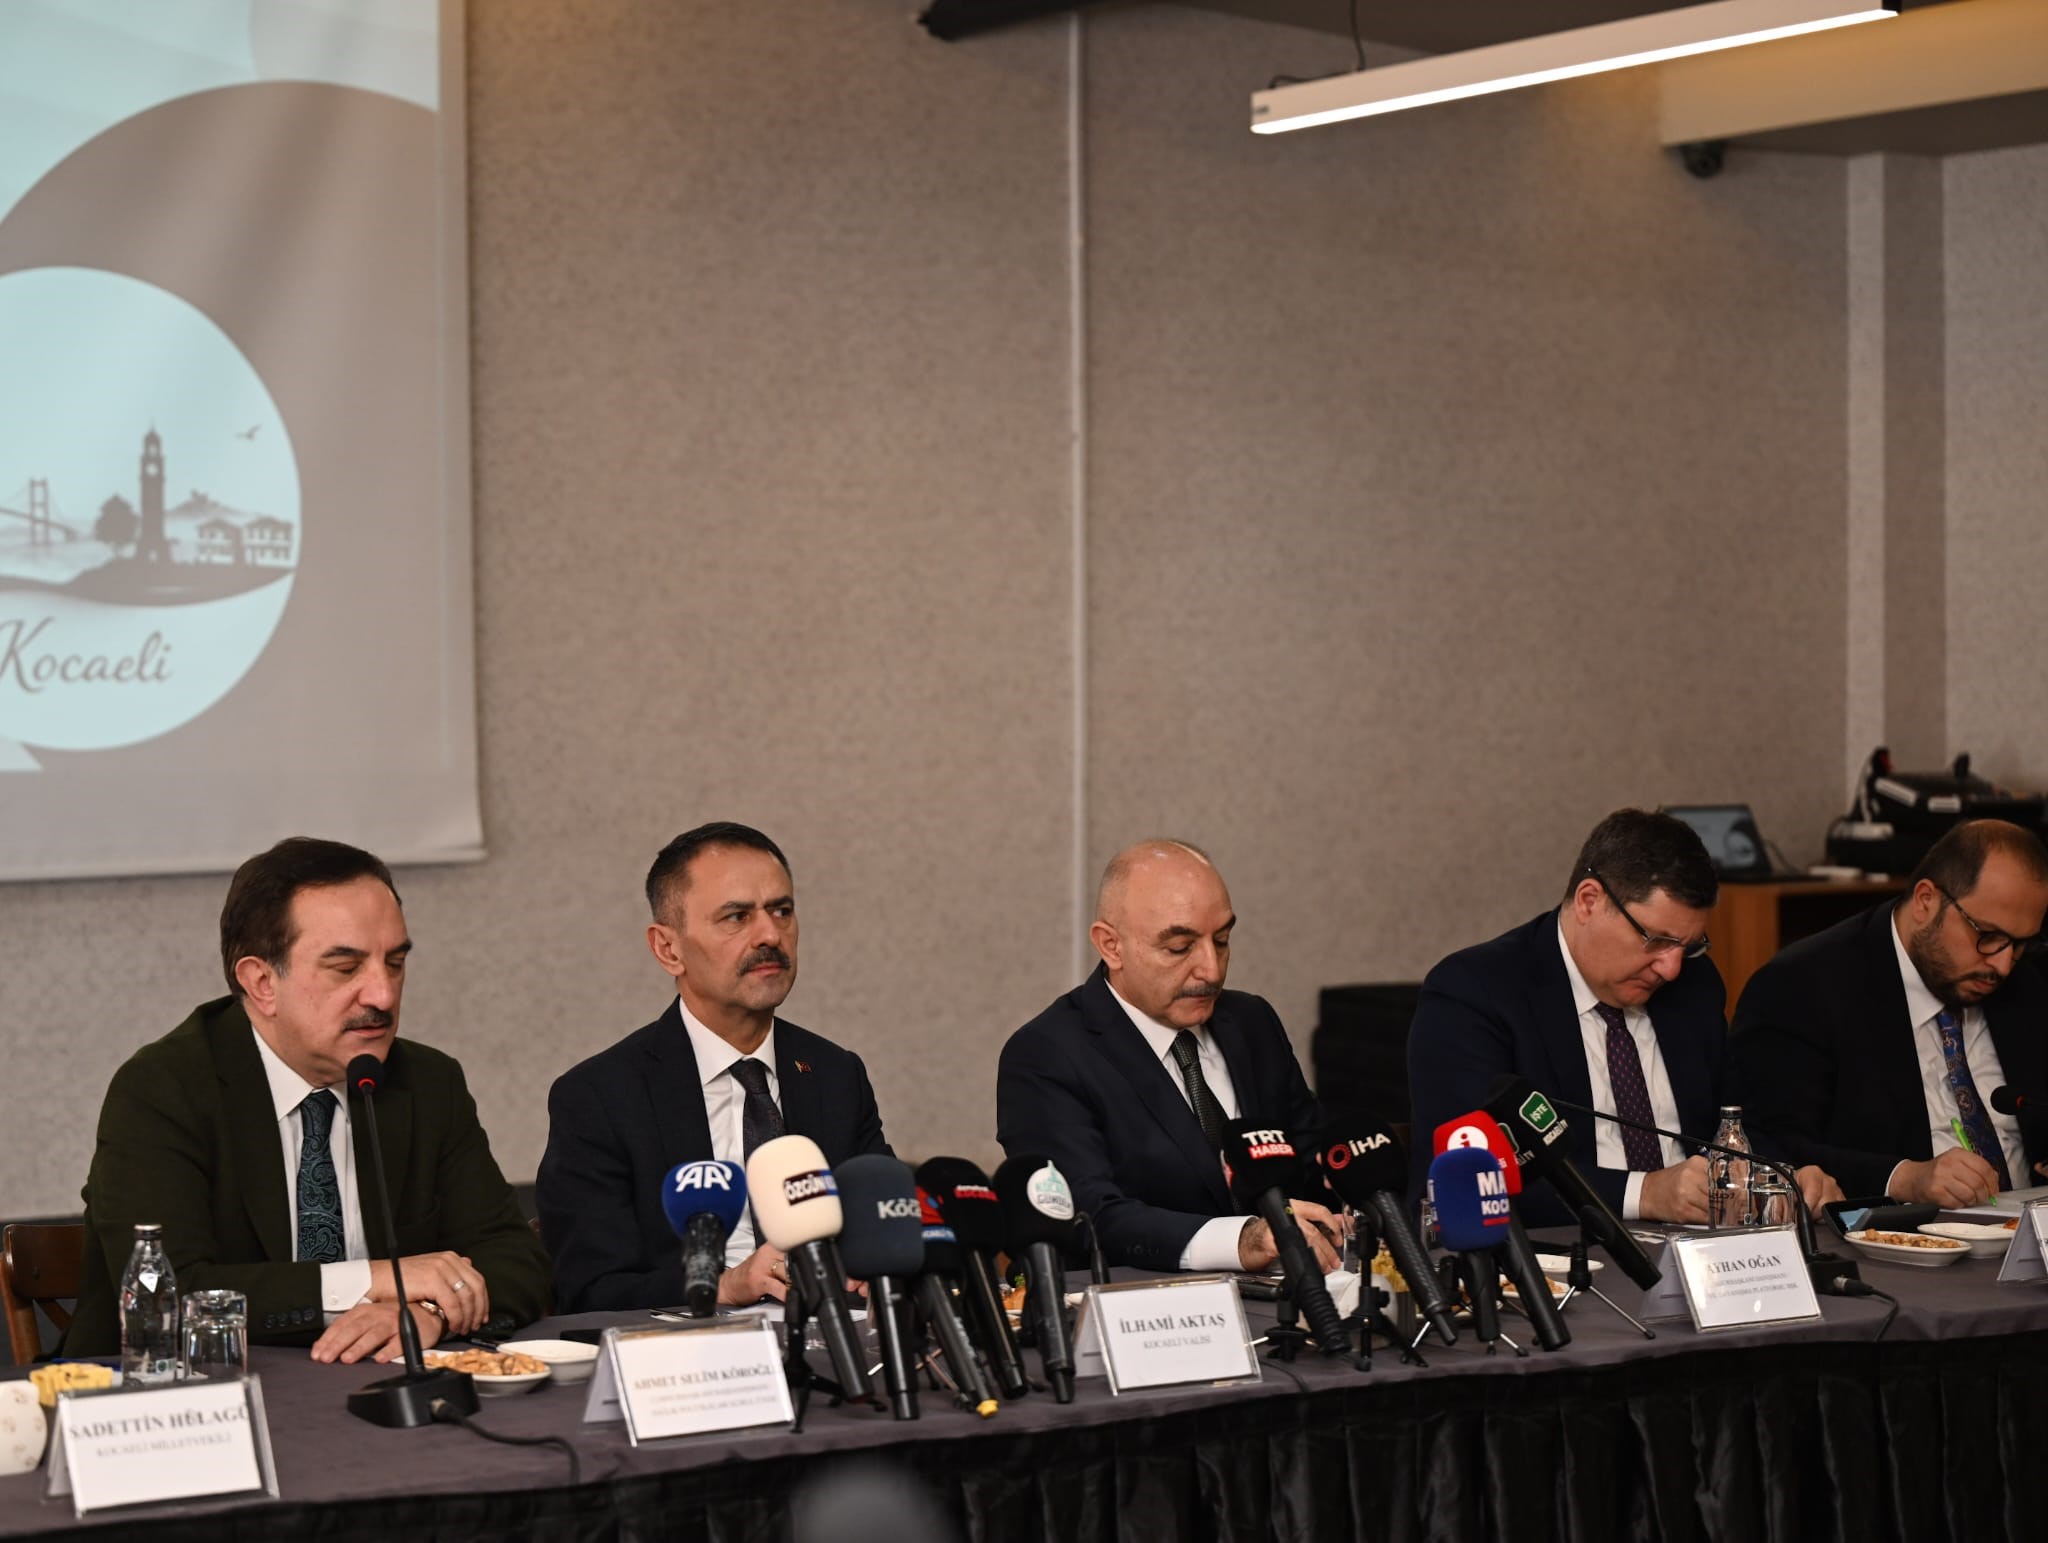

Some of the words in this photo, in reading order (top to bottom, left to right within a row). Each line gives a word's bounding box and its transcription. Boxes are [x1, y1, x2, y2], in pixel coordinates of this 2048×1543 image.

[0, 616, 173, 694] Kocaeli
[1241, 1129, 1287, 1147] TRT
[1348, 1133, 1392, 1157] İHA
[1250, 1144, 1295, 1158] HABER
[675, 1161, 733, 1193] AA
[1706, 1259, 1747, 1274] AYHAN
[1748, 1254, 1782, 1269] OĞAN
[1120, 1314, 1175, 1334] İLHAMİ
[1179, 1313, 1227, 1329] AKTAŞ
[680, 1369, 719, 1385] SELİM
[69, 1411, 165, 1439] SADETTİN
